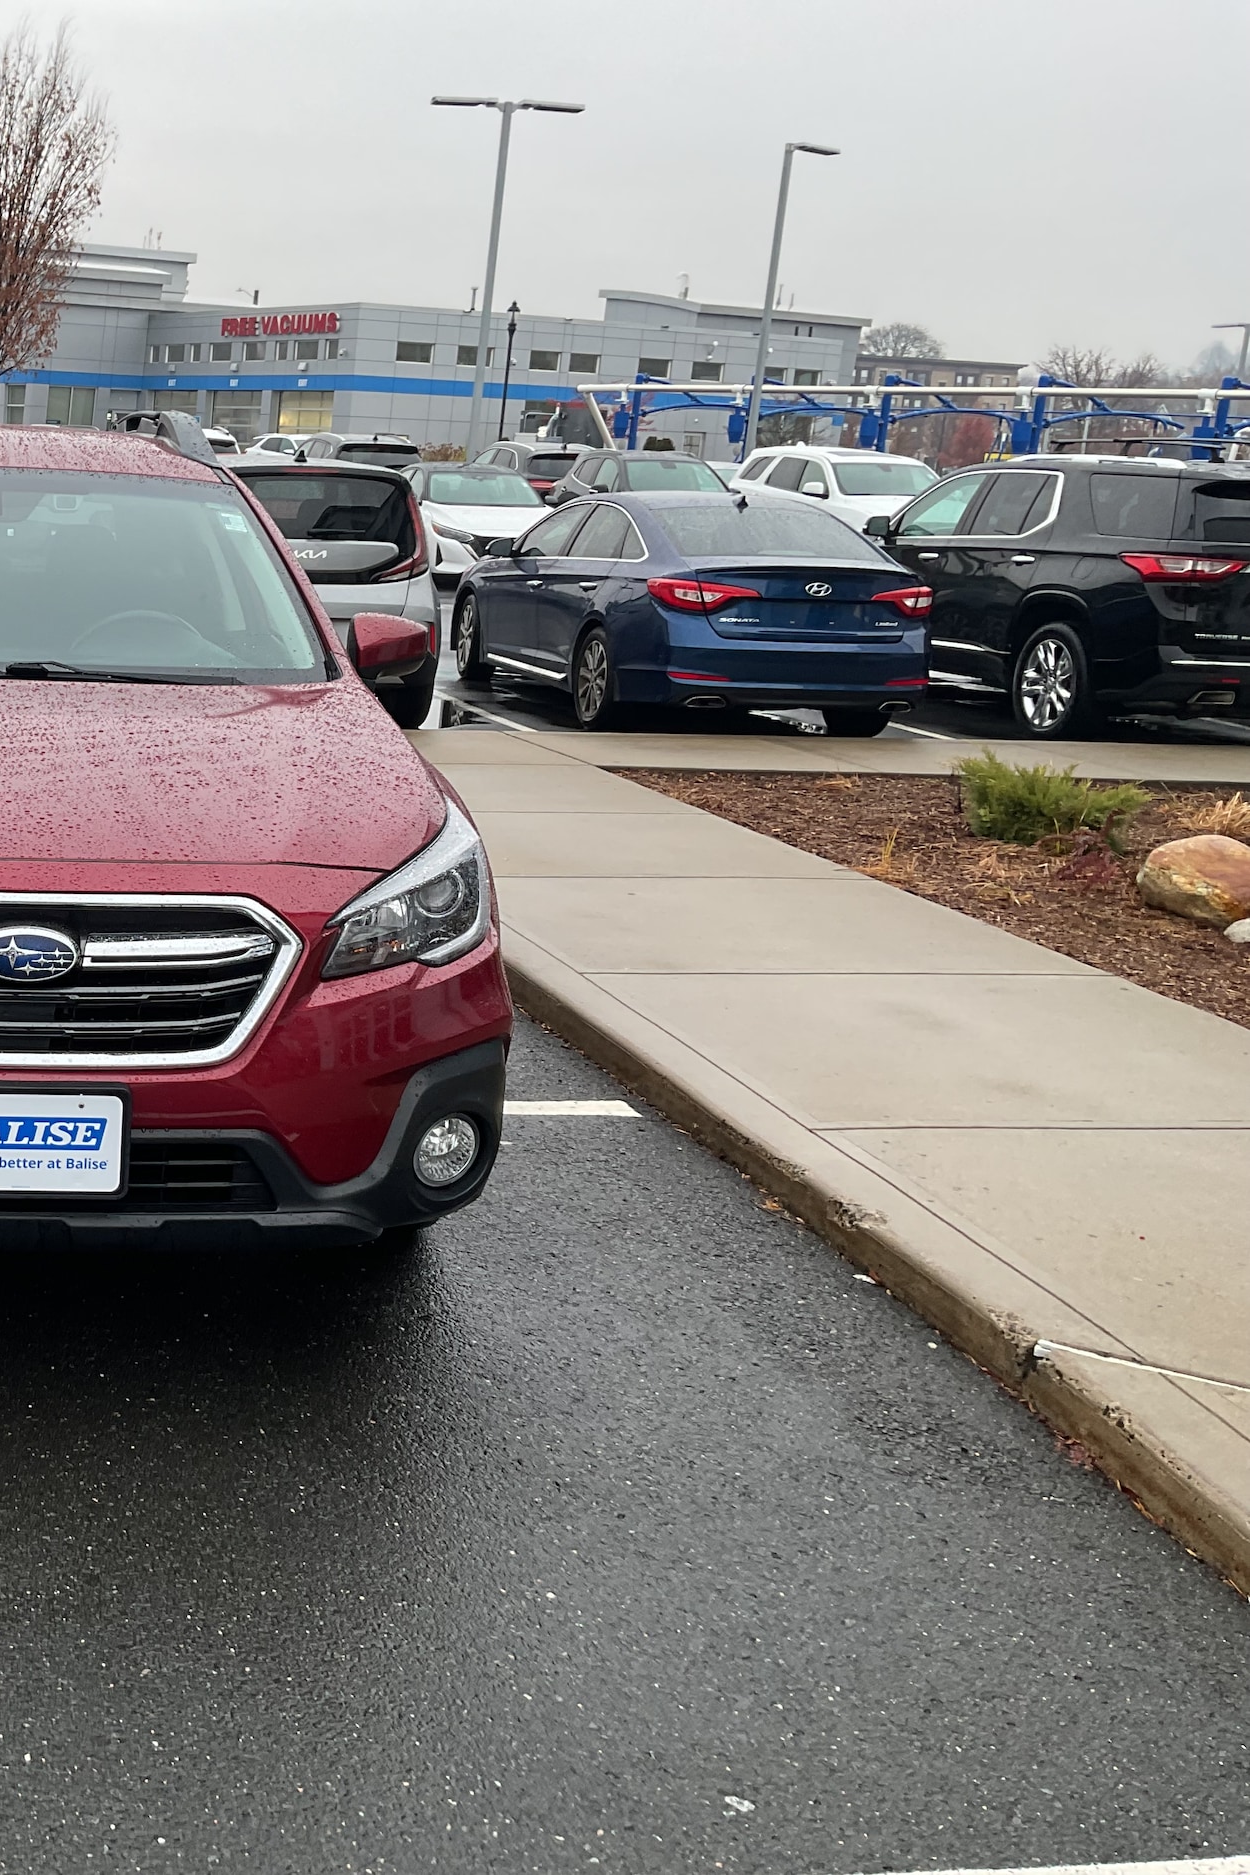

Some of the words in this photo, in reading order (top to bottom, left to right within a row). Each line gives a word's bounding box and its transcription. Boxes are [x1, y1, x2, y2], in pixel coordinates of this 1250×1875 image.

[221, 317, 259, 337] FREE
[261, 312, 340, 335] VACUUMS
[0, 1157, 43, 1168] better
[47, 1157, 62, 1169] at
[66, 1158, 108, 1170] Balise
